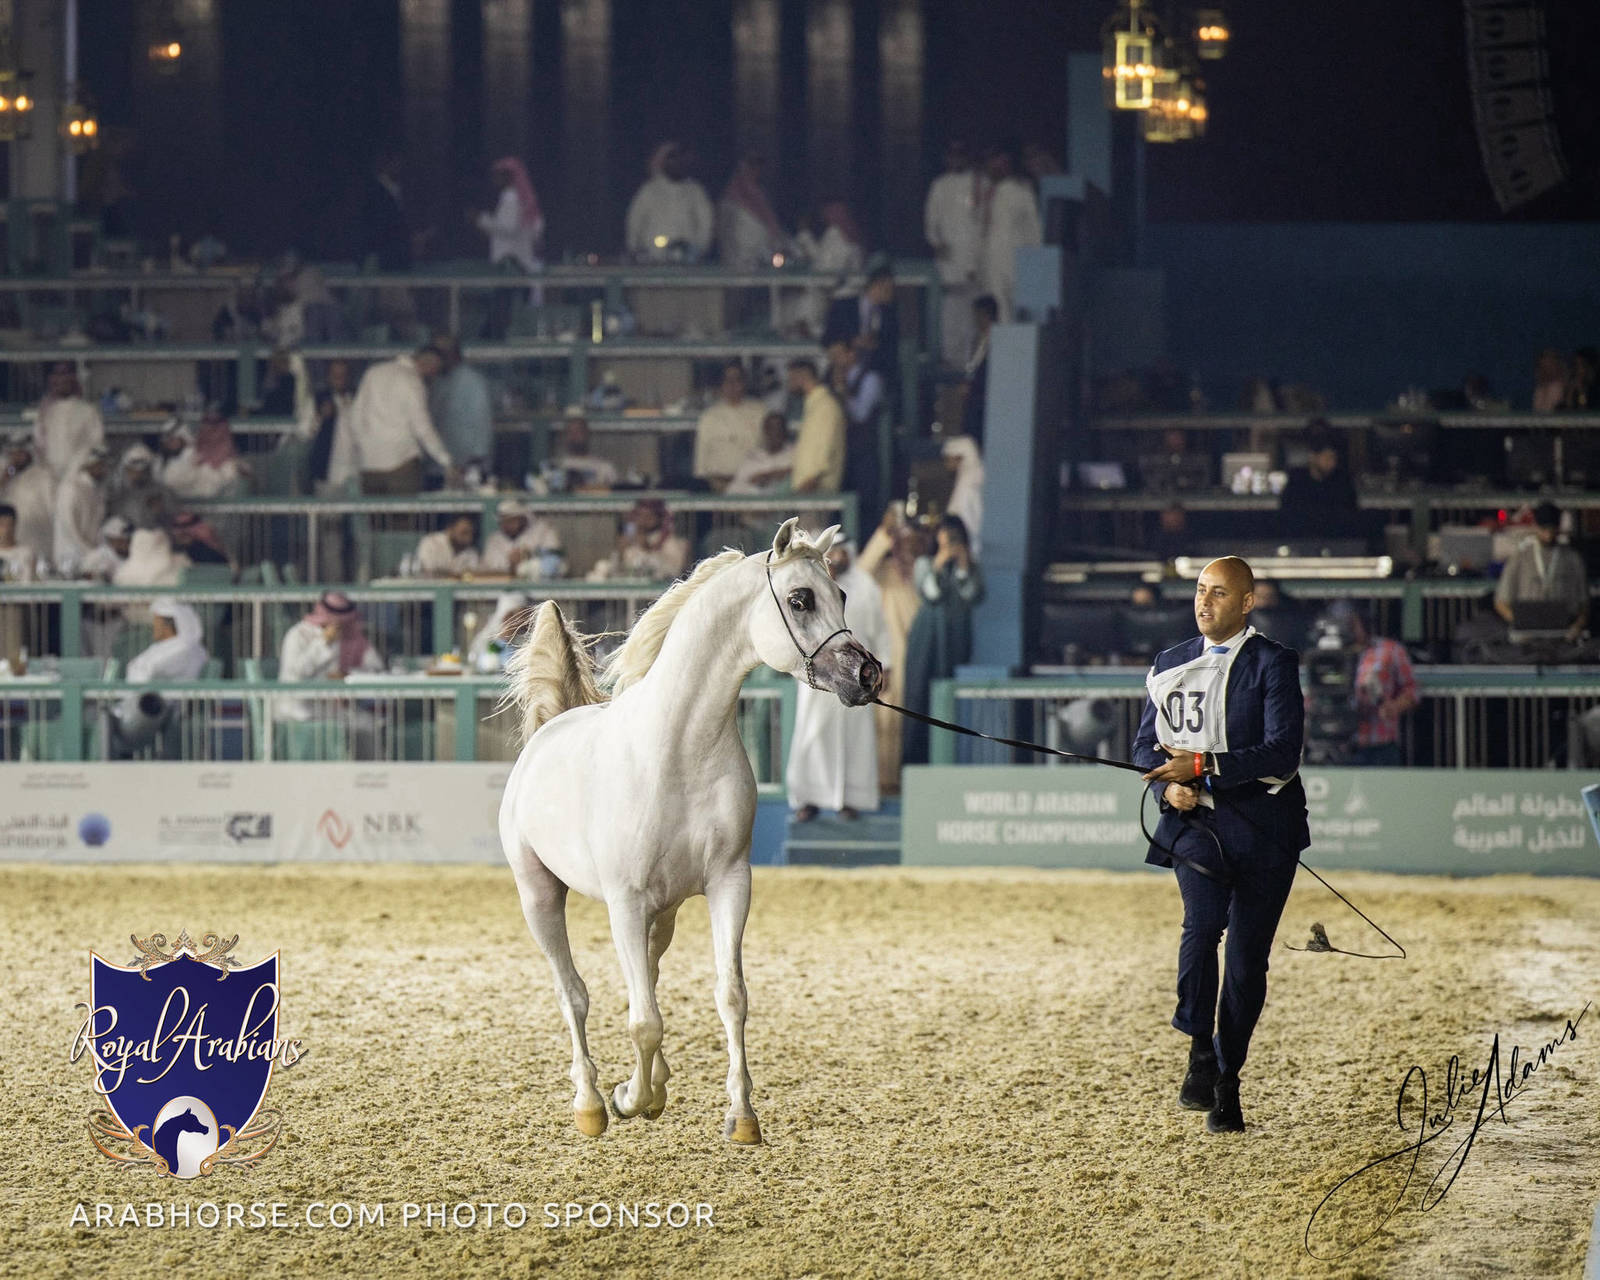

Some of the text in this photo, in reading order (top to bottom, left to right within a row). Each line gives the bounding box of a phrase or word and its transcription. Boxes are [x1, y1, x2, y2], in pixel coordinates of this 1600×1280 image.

[963, 791, 1117, 814] WORLD ARABIAN
[1453, 792, 1516, 821] العالم
[363, 812, 423, 834] NBK
[937, 820, 999, 844] HORSE
[1454, 825, 1586, 853] للخيل العربية
